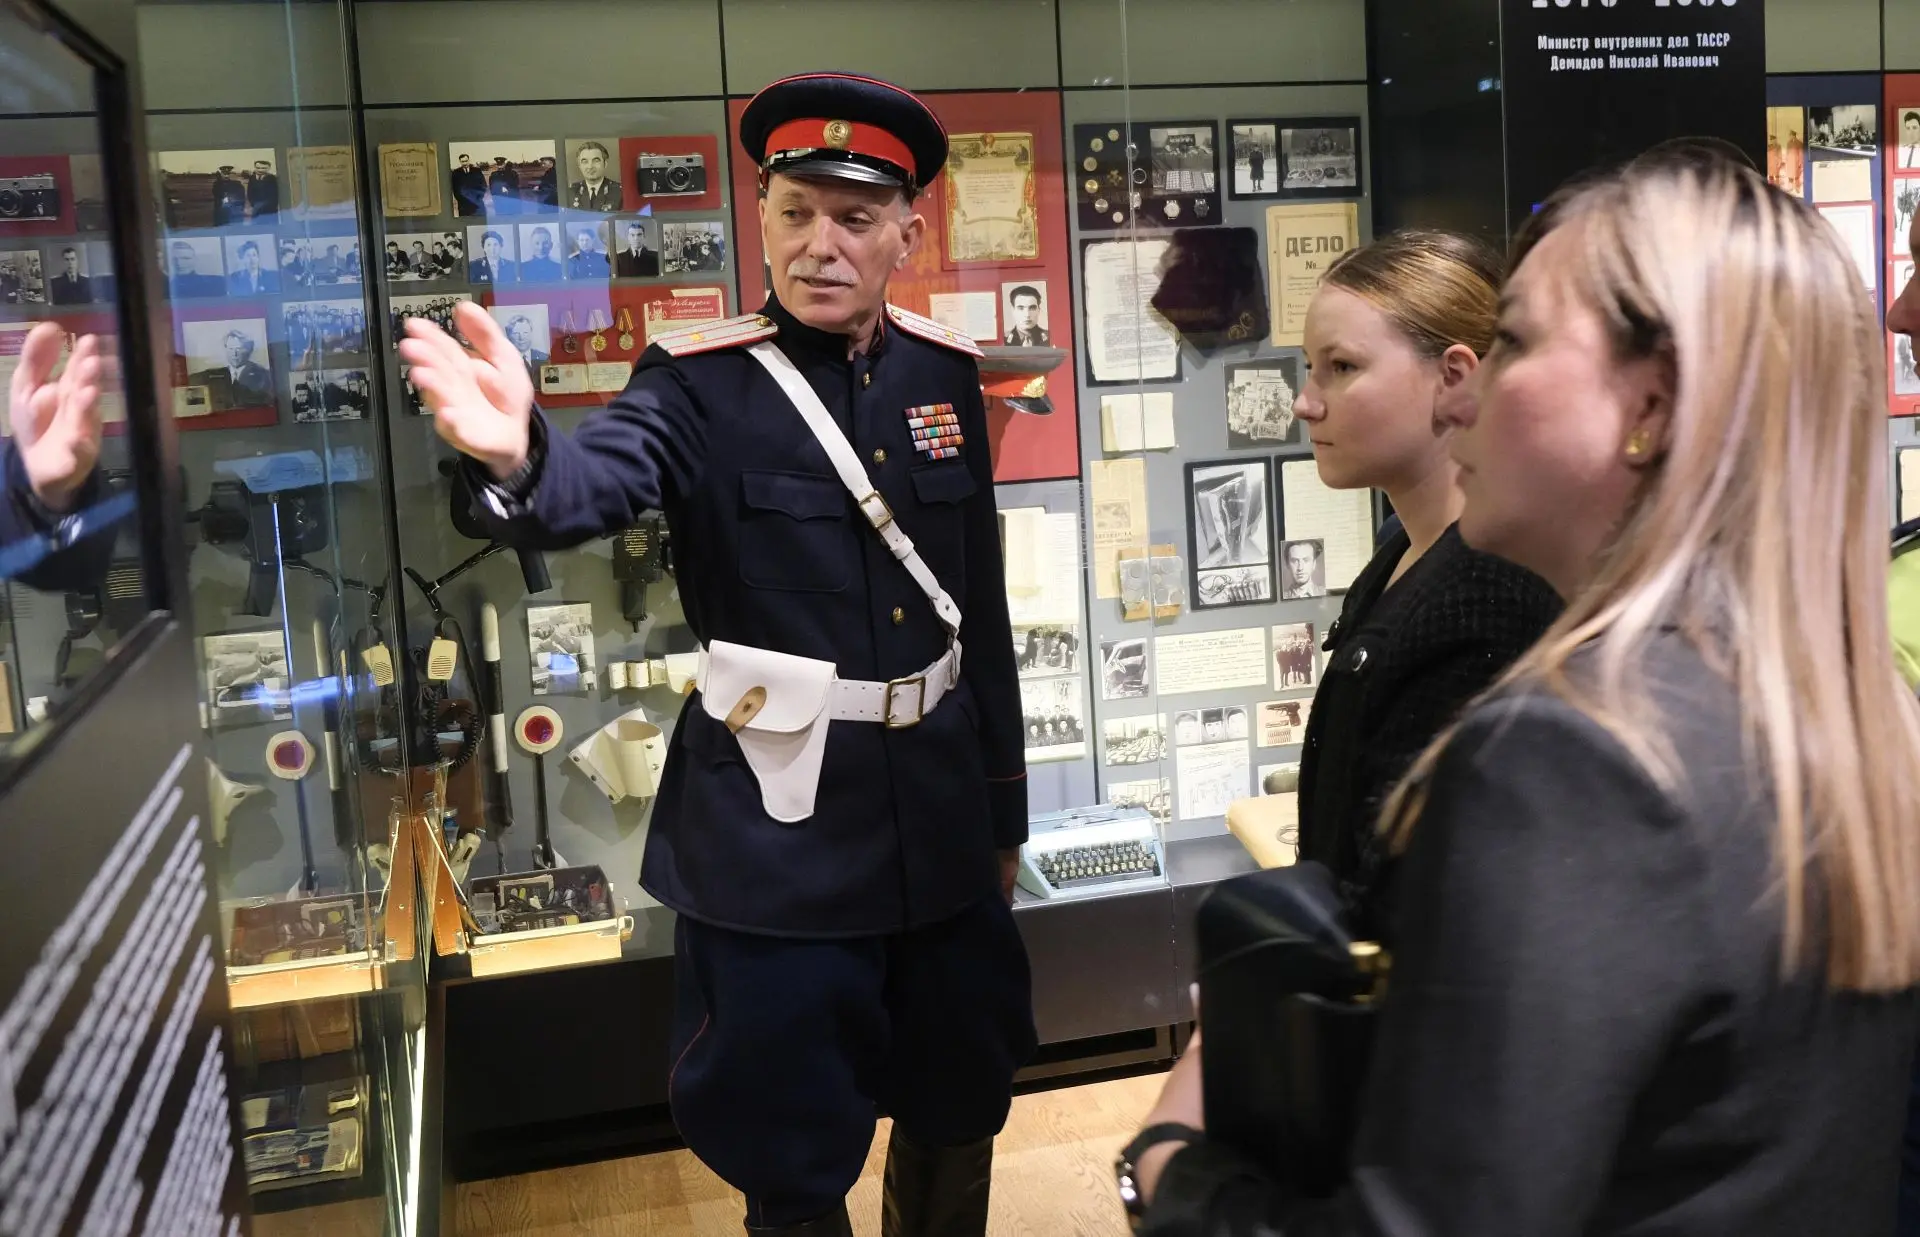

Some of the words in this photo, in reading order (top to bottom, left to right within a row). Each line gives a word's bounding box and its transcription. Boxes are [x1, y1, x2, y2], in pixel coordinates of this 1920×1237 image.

[1537, 35, 1589, 51] Министр
[1594, 36, 1663, 51] внутренних
[1667, 36, 1689, 49] дел
[1696, 32, 1731, 47] ТАССР
[1550, 55, 1604, 71] Демидов
[1609, 54, 1659, 69] Николай
[1663, 53, 1720, 68] Иванович
[1285, 235, 1344, 258] ДЕЛО
